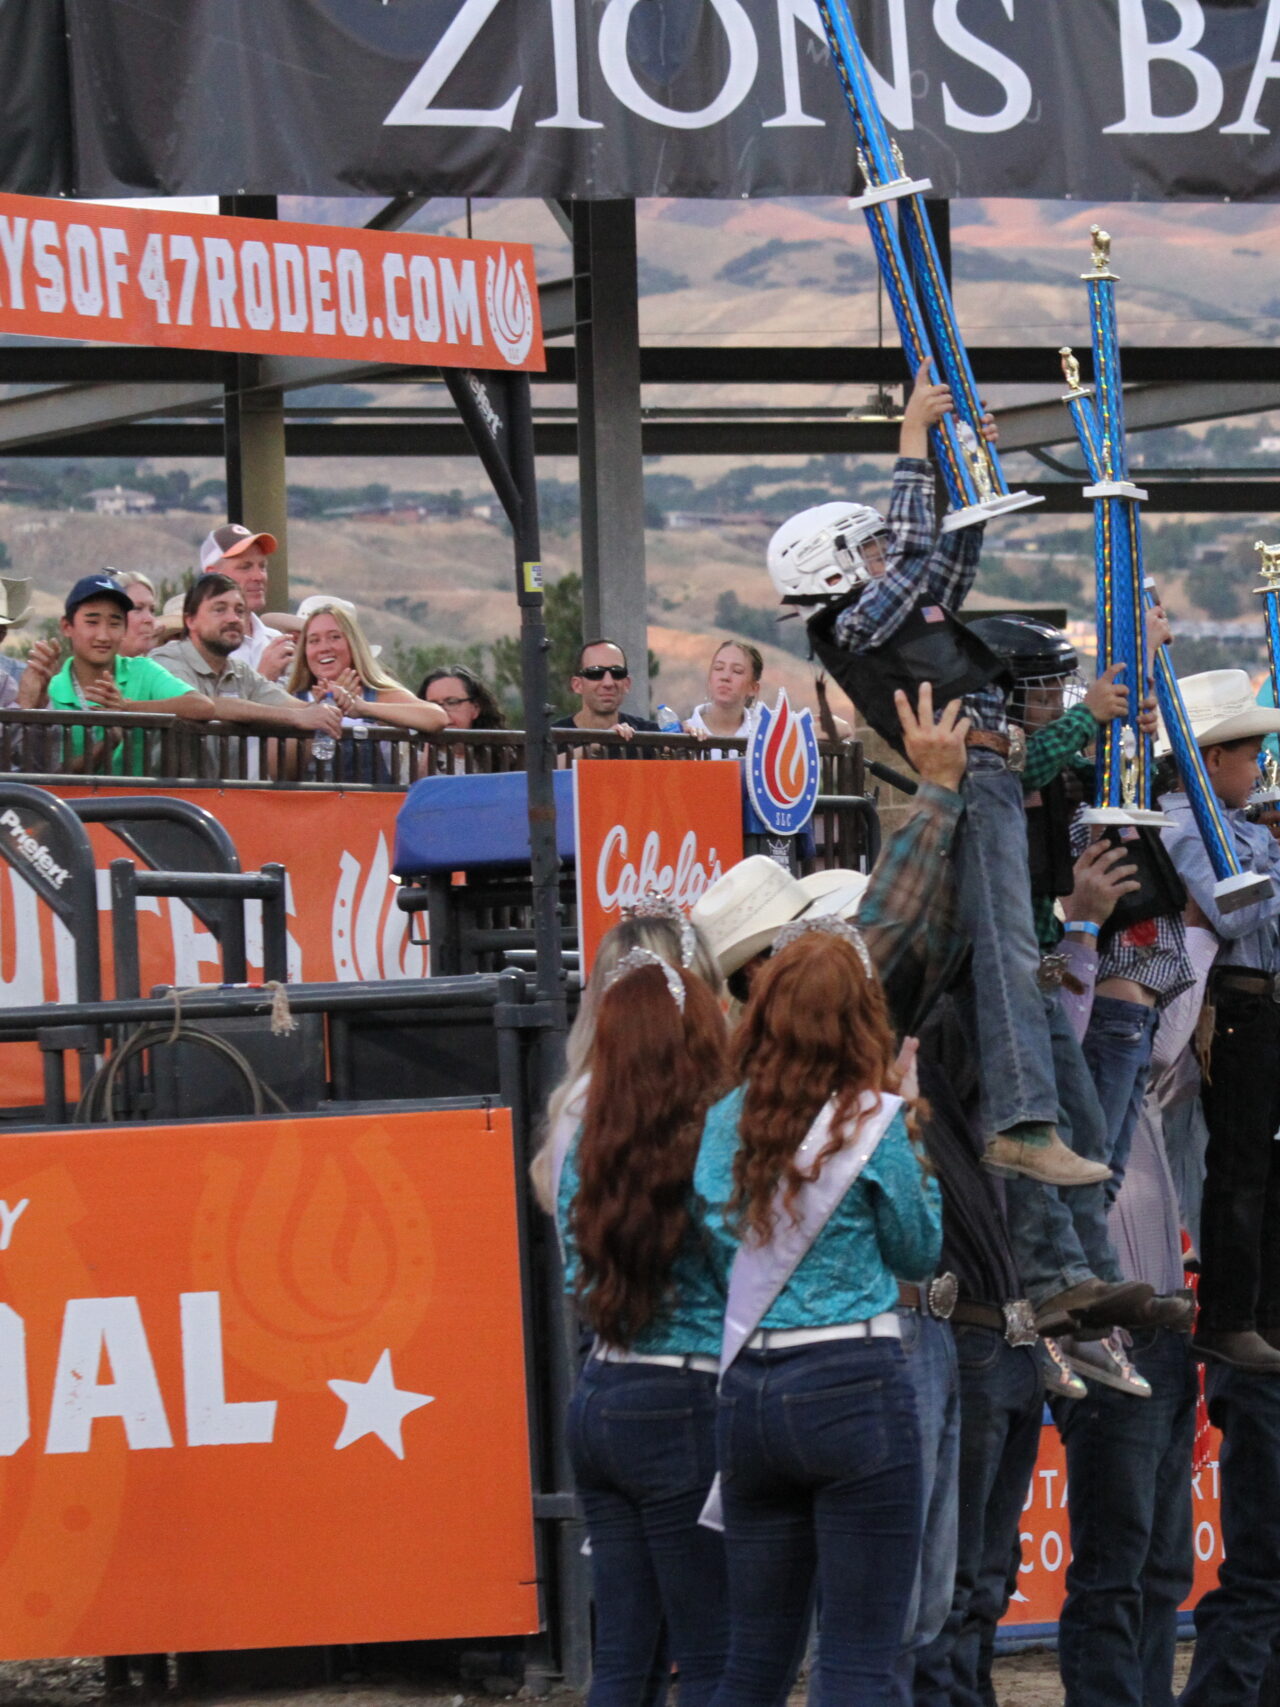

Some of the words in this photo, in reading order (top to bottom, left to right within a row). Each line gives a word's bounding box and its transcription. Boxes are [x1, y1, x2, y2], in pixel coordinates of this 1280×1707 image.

[382, 0, 1032, 133] ZIONS
[0, 213, 484, 347] YSOF47RODEO.COM
[0, 808, 74, 886] Priefert
[775, 811, 792, 827] SLC
[596, 824, 723, 912] Cabela's
